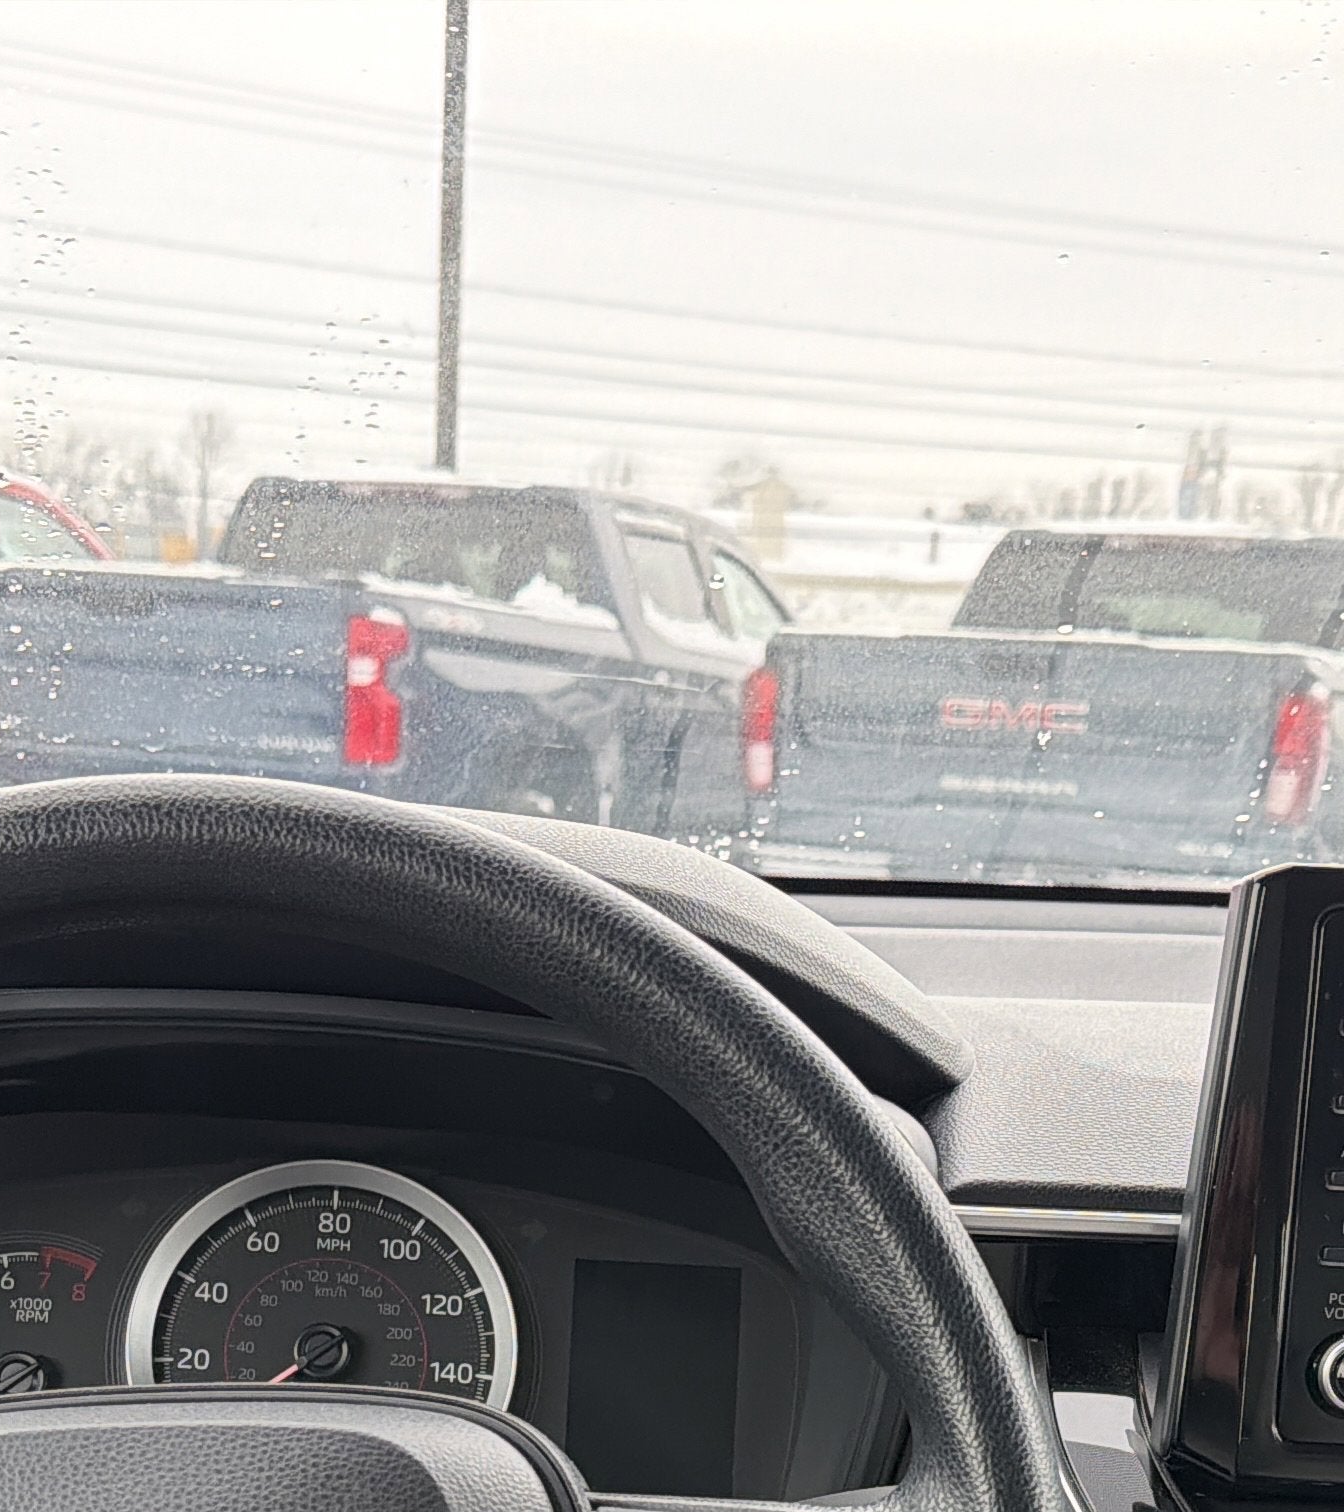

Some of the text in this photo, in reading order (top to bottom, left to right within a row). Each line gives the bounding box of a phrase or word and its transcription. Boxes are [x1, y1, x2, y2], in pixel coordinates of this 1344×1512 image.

[941, 697, 1090, 734] GMC
[318, 1212, 351, 1234] 80
[246, 1231, 280, 1253] 60
[316, 1238, 351, 1252] MPH
[379, 1238, 421, 1261] 100
[0, 1271, 15, 1290] 6
[38, 1271, 52, 1289] 7
[307, 1270, 329, 1283] 120
[336, 1272, 359, 1285] 140
[71, 1283, 86, 1302] 8
[194, 1281, 229, 1304] 40
[280, 1280, 303, 1293] 100
[314, 1285, 347, 1299] km/h
[359, 1286, 383, 1299] 160
[9, 1297, 53, 1311] x1000
[260, 1294, 278, 1307] 80
[421, 1293, 463, 1316] 120
[15, 1309, 49, 1324] RPM
[377, 1303, 401, 1317] 180
[244, 1314, 263, 1327] 60
[386, 1327, 413, 1340] 200
[236, 1341, 255, 1354] 40
[177, 1348, 210, 1370] 20
[390, 1354, 416, 1367] 220
[238, 1368, 256, 1381] 20
[429, 1361, 473, 1384] 140
